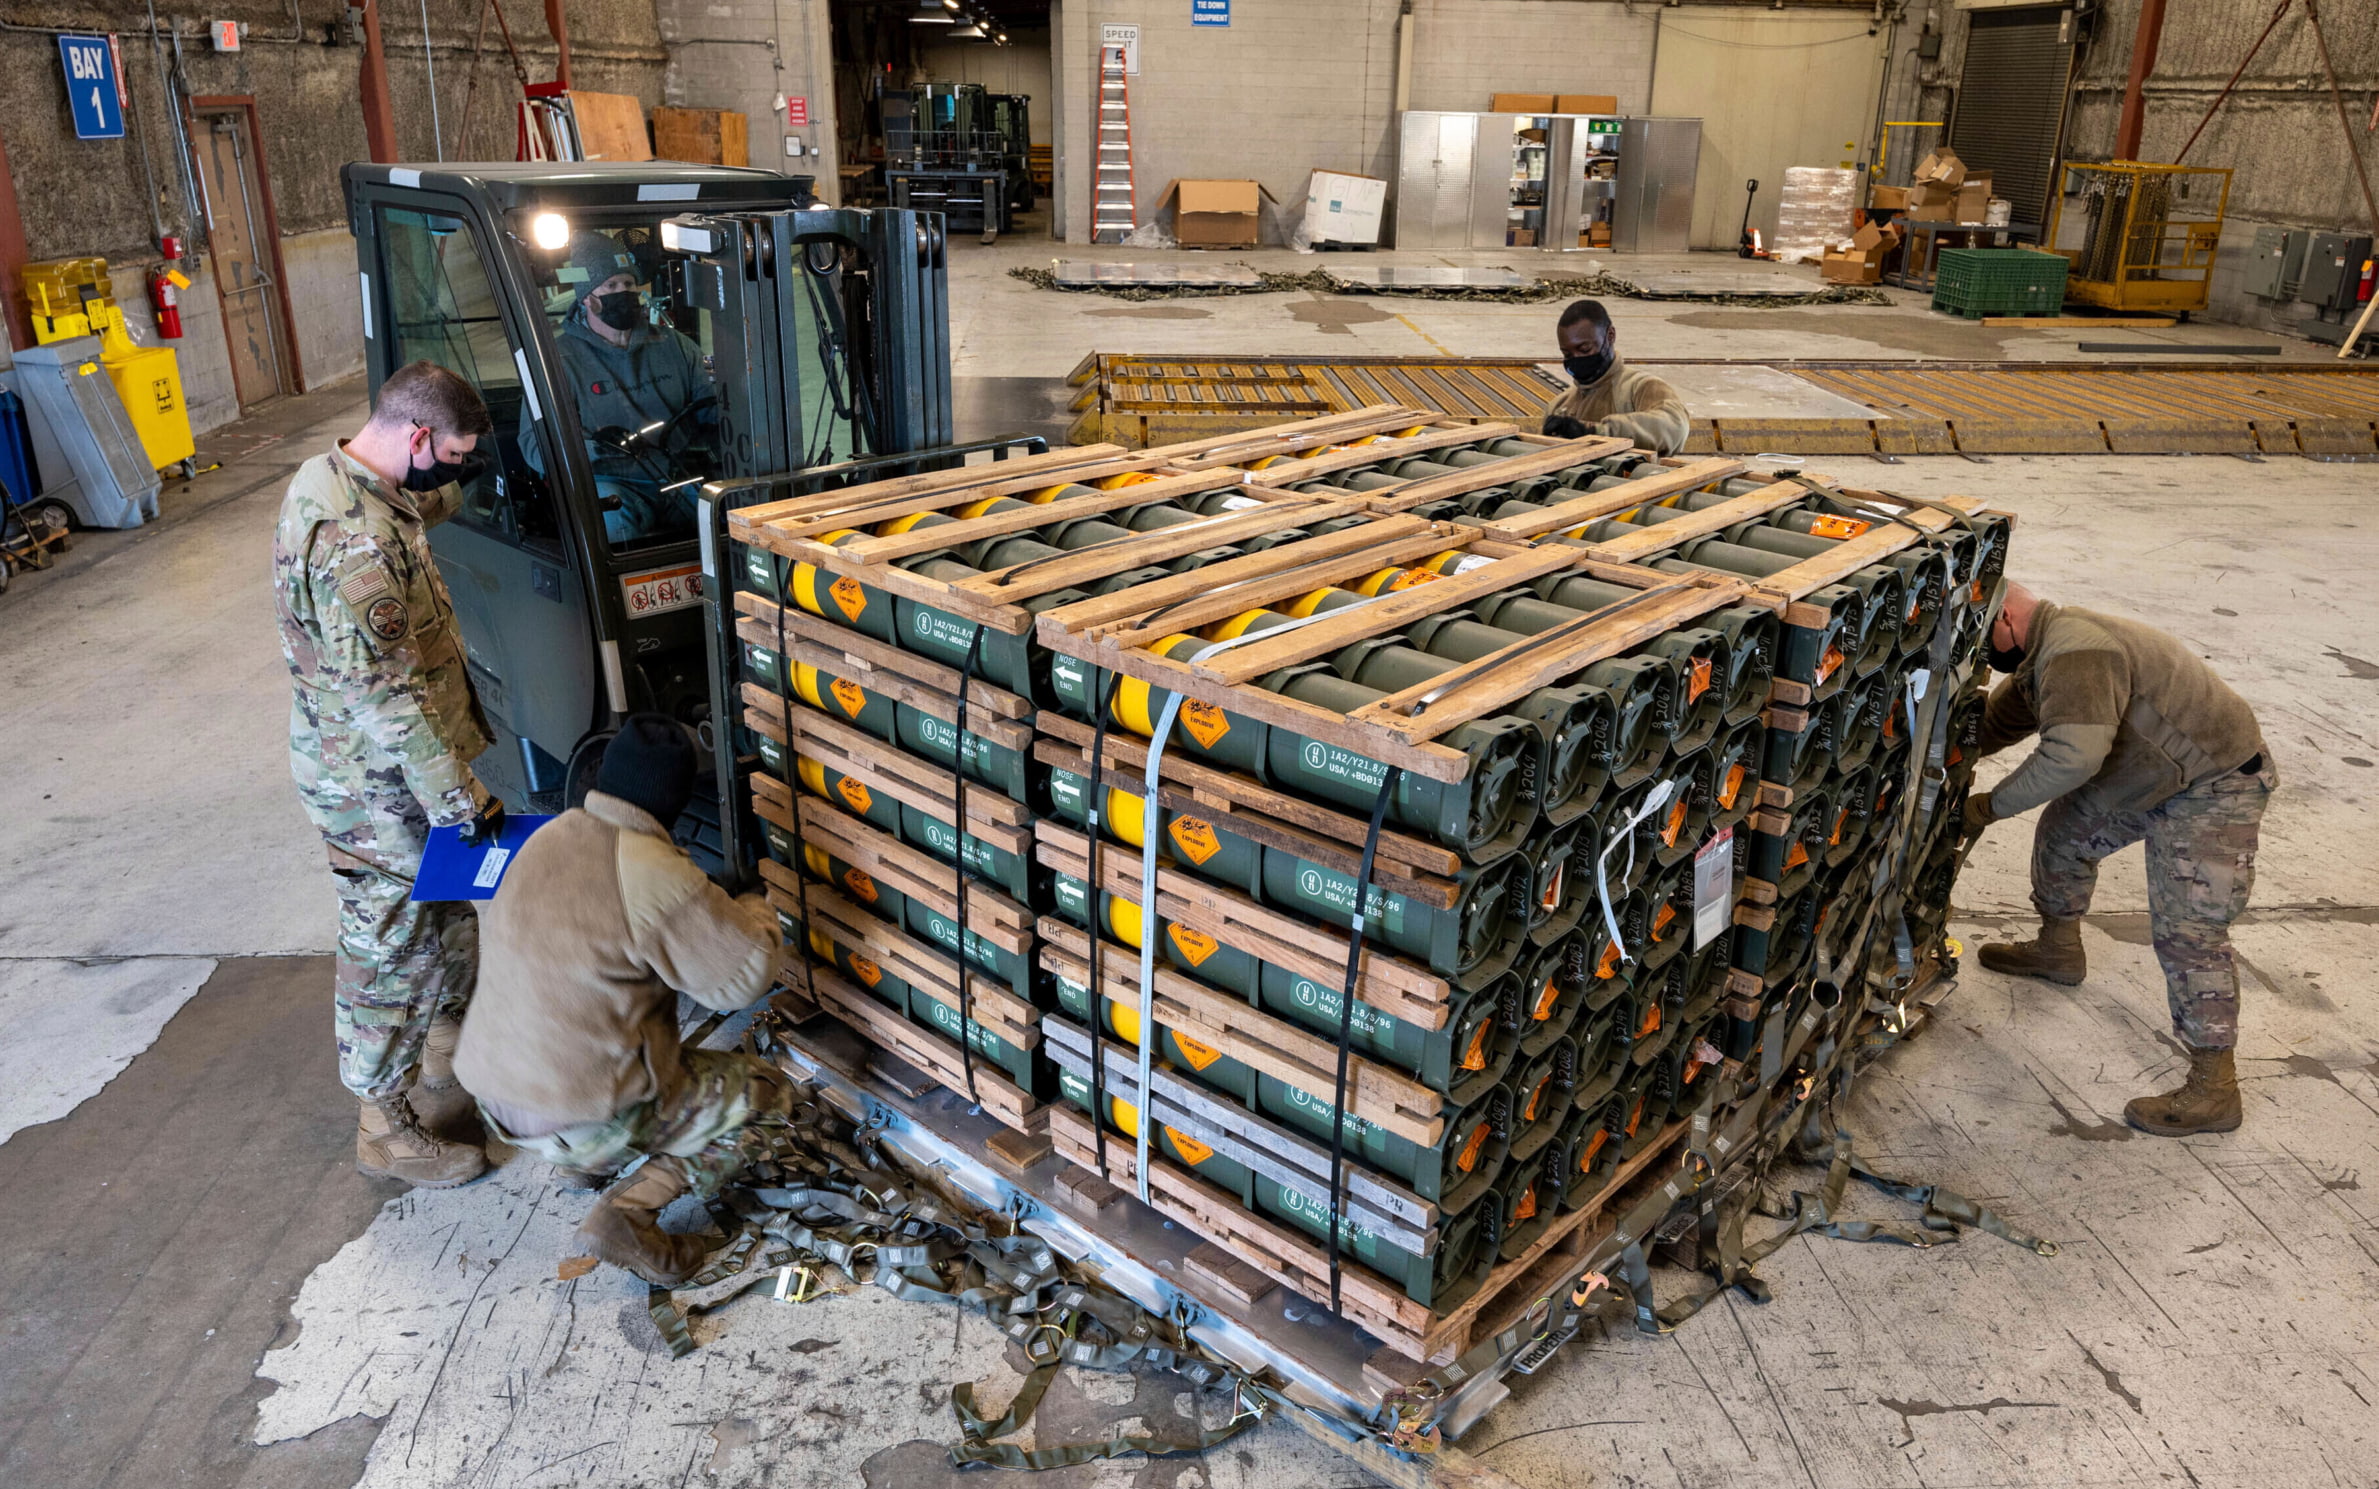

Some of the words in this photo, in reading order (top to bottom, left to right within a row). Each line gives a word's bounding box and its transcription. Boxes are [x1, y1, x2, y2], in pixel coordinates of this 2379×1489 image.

[1105, 30, 1136, 39] SPEED
[69, 46, 104, 79] BAY
[91, 87, 105, 129] 1
[1991, 534, 2005, 559] 1580
[1926, 574, 1940, 599] 1577
[1886, 589, 1898, 618] 1576
[1058, 654, 1077, 667] NOSE
[1059, 681, 1073, 691] END
[1709, 664, 1724, 691] 2070
[1656, 686, 1670, 719] 2069
[1868, 685, 1884, 714] 1571
[1190, 716, 1215, 729] EXPLOSIVE
[1593, 717, 1609, 750] 2068
[1820, 712, 1832, 736] 1570
[1056, 768, 1074, 781] NOSE
[1329, 763, 1349, 777] USA/
[1352, 772, 1383, 787] +BD013
[1330, 750, 1406, 781] 1A2/Y21.8/S6
[1521, 754, 1536, 787] 2067
[1057, 794, 1071, 805] END
[1181, 835, 1205, 848] EXPLOSIVE
[1062, 895, 1075, 906] END
[1325, 891, 1345, 904] USA/
[1326, 879, 1400, 912] 1A2/Y28/S/96
[1511, 876, 1528, 909] 2072
[1628, 909, 1641, 936] 2084
[1180, 934, 1204, 948] EXPLOSIVE
[1568, 943, 1583, 972] 2083
[1063, 987, 1076, 999] END
[1503, 988, 1516, 1021] 2082
[1319, 1003, 1337, 1017] USA/
[1184, 1039, 1207, 1054] EXPLOSIVE
[1067, 1088, 1080, 1098] END
[1312, 1102, 1331, 1118] USA/
[1492, 1099, 1506, 1130] 2087
